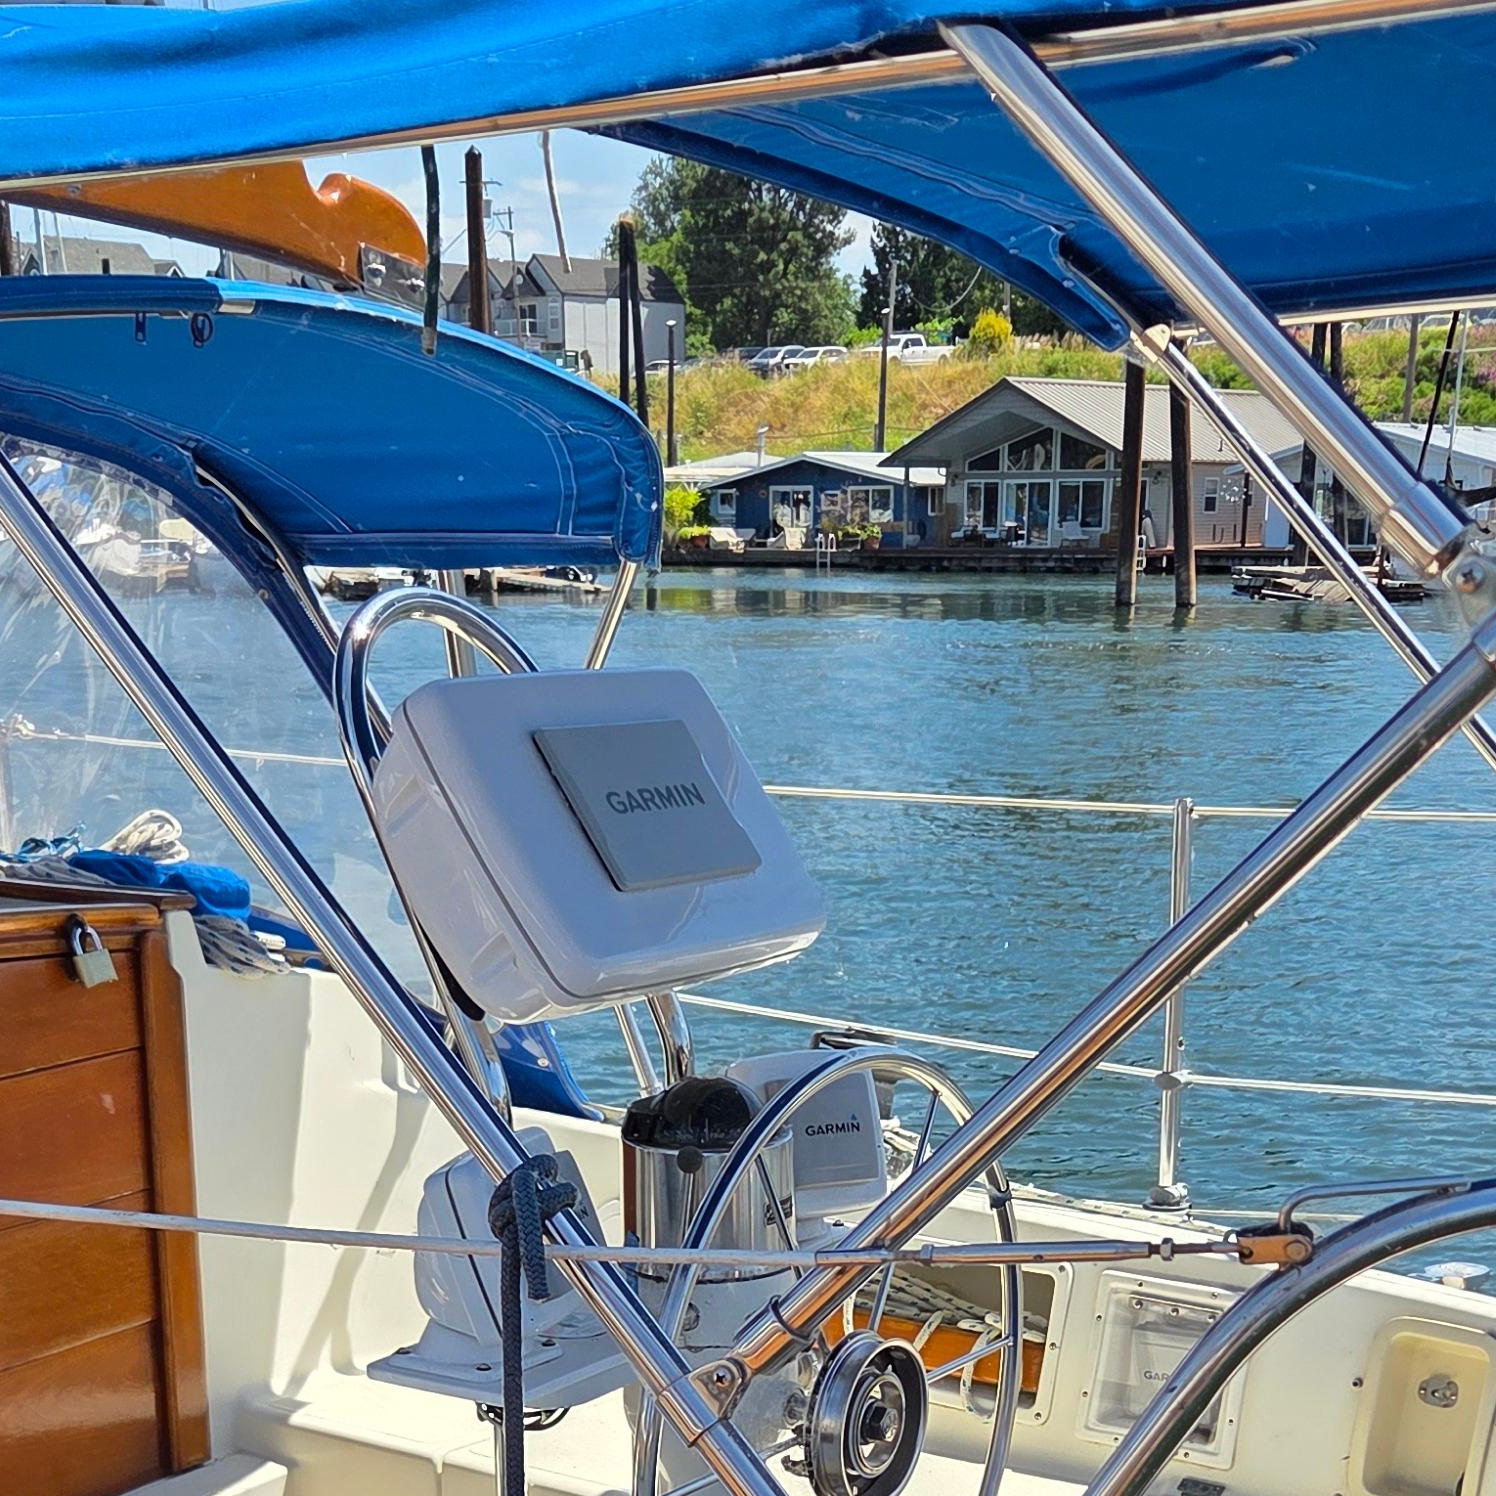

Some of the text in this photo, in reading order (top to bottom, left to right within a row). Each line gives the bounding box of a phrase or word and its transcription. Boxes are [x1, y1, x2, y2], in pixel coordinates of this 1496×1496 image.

[605, 782, 706, 814] GARMIN
[805, 1121, 861, 1136] GARMIN
[1144, 1370, 1170, 1381] GAR
